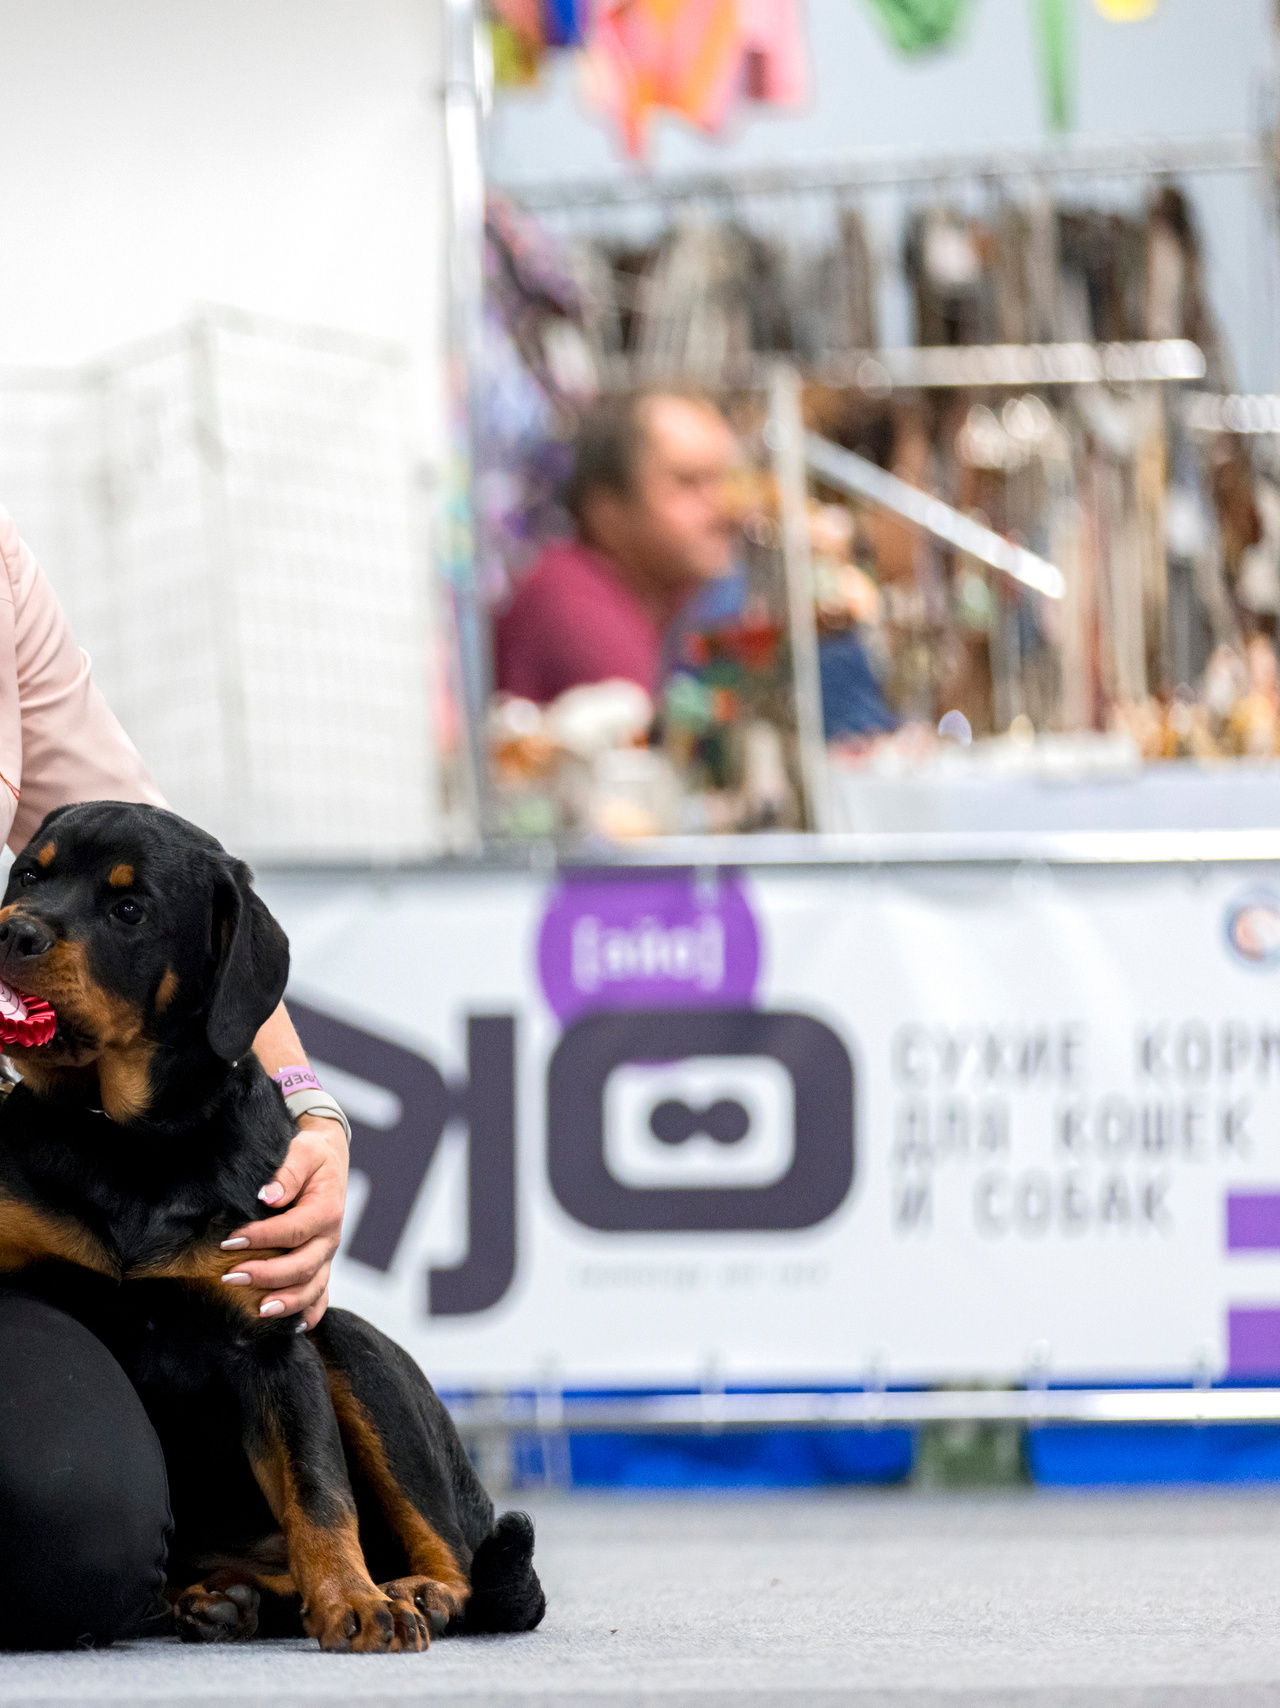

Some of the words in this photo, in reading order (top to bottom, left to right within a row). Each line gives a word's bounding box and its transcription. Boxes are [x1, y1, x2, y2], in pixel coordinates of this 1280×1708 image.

[892, 1020, 1086, 1087] СУХИЕ
[890, 1094, 1011, 1166] ДЛЯ
[1054, 1093, 1255, 1161] КОШЕК
[974, 1170, 1173, 1237] СОБАК
